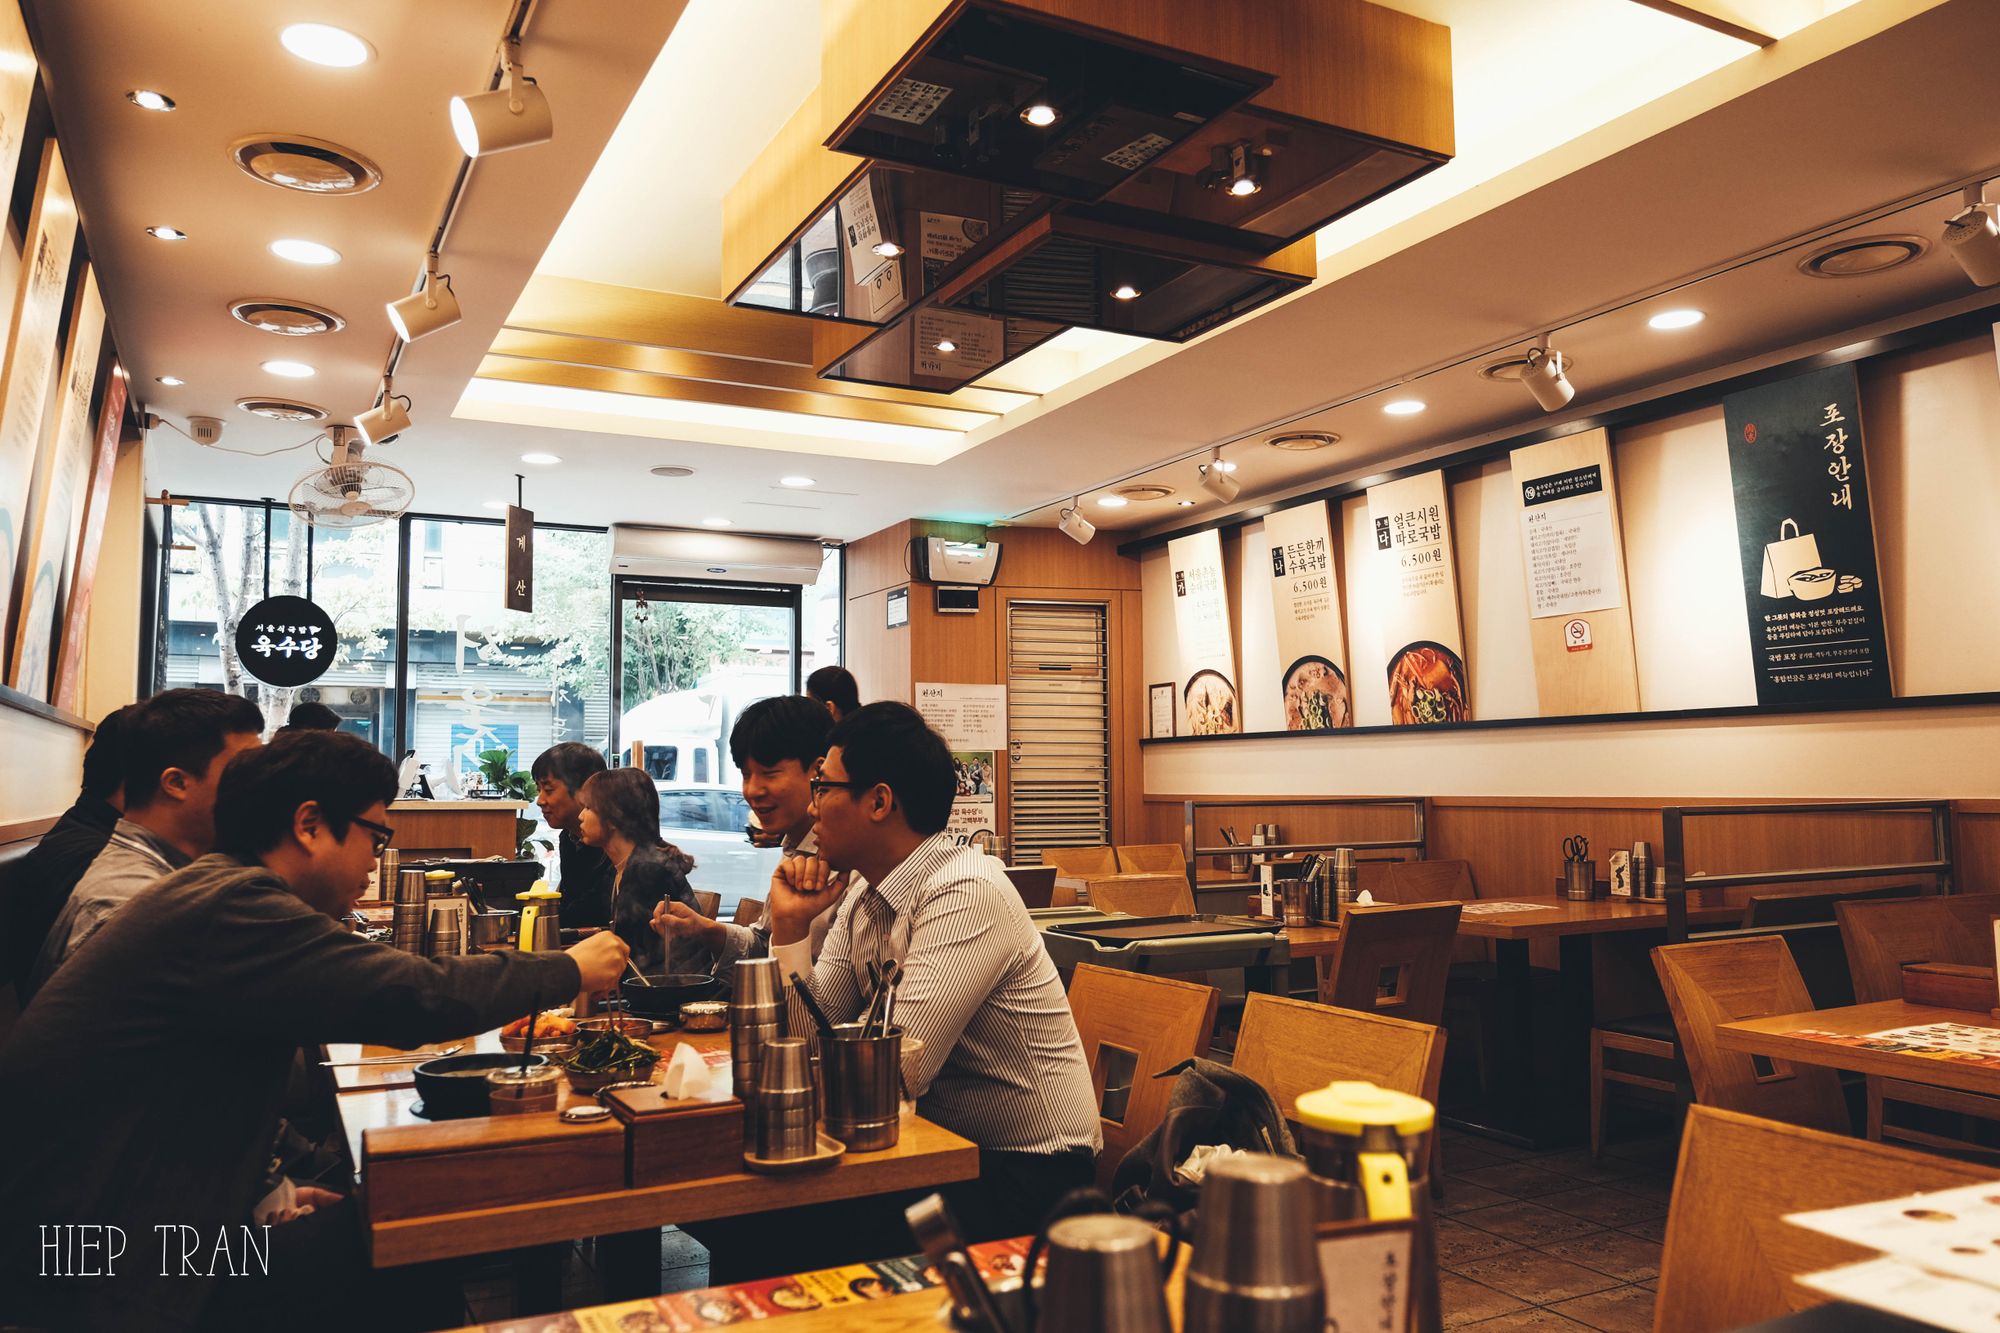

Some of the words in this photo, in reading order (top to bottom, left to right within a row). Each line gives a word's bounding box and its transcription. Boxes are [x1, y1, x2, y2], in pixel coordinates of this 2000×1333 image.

[1820, 402, 1854, 511] 포장안내
[1393, 504, 1441, 530] 얼큰시원
[1287, 536, 1325, 559] 든든한끼
[1378, 531, 1390, 547] 다
[1395, 523, 1442, 548] 따로국밥
[515, 534, 527, 597] 계산
[1288, 553, 1327, 576] 수육국밥
[250, 634, 323, 660] 육수당
[1783, 652, 1797, 661] 포장
